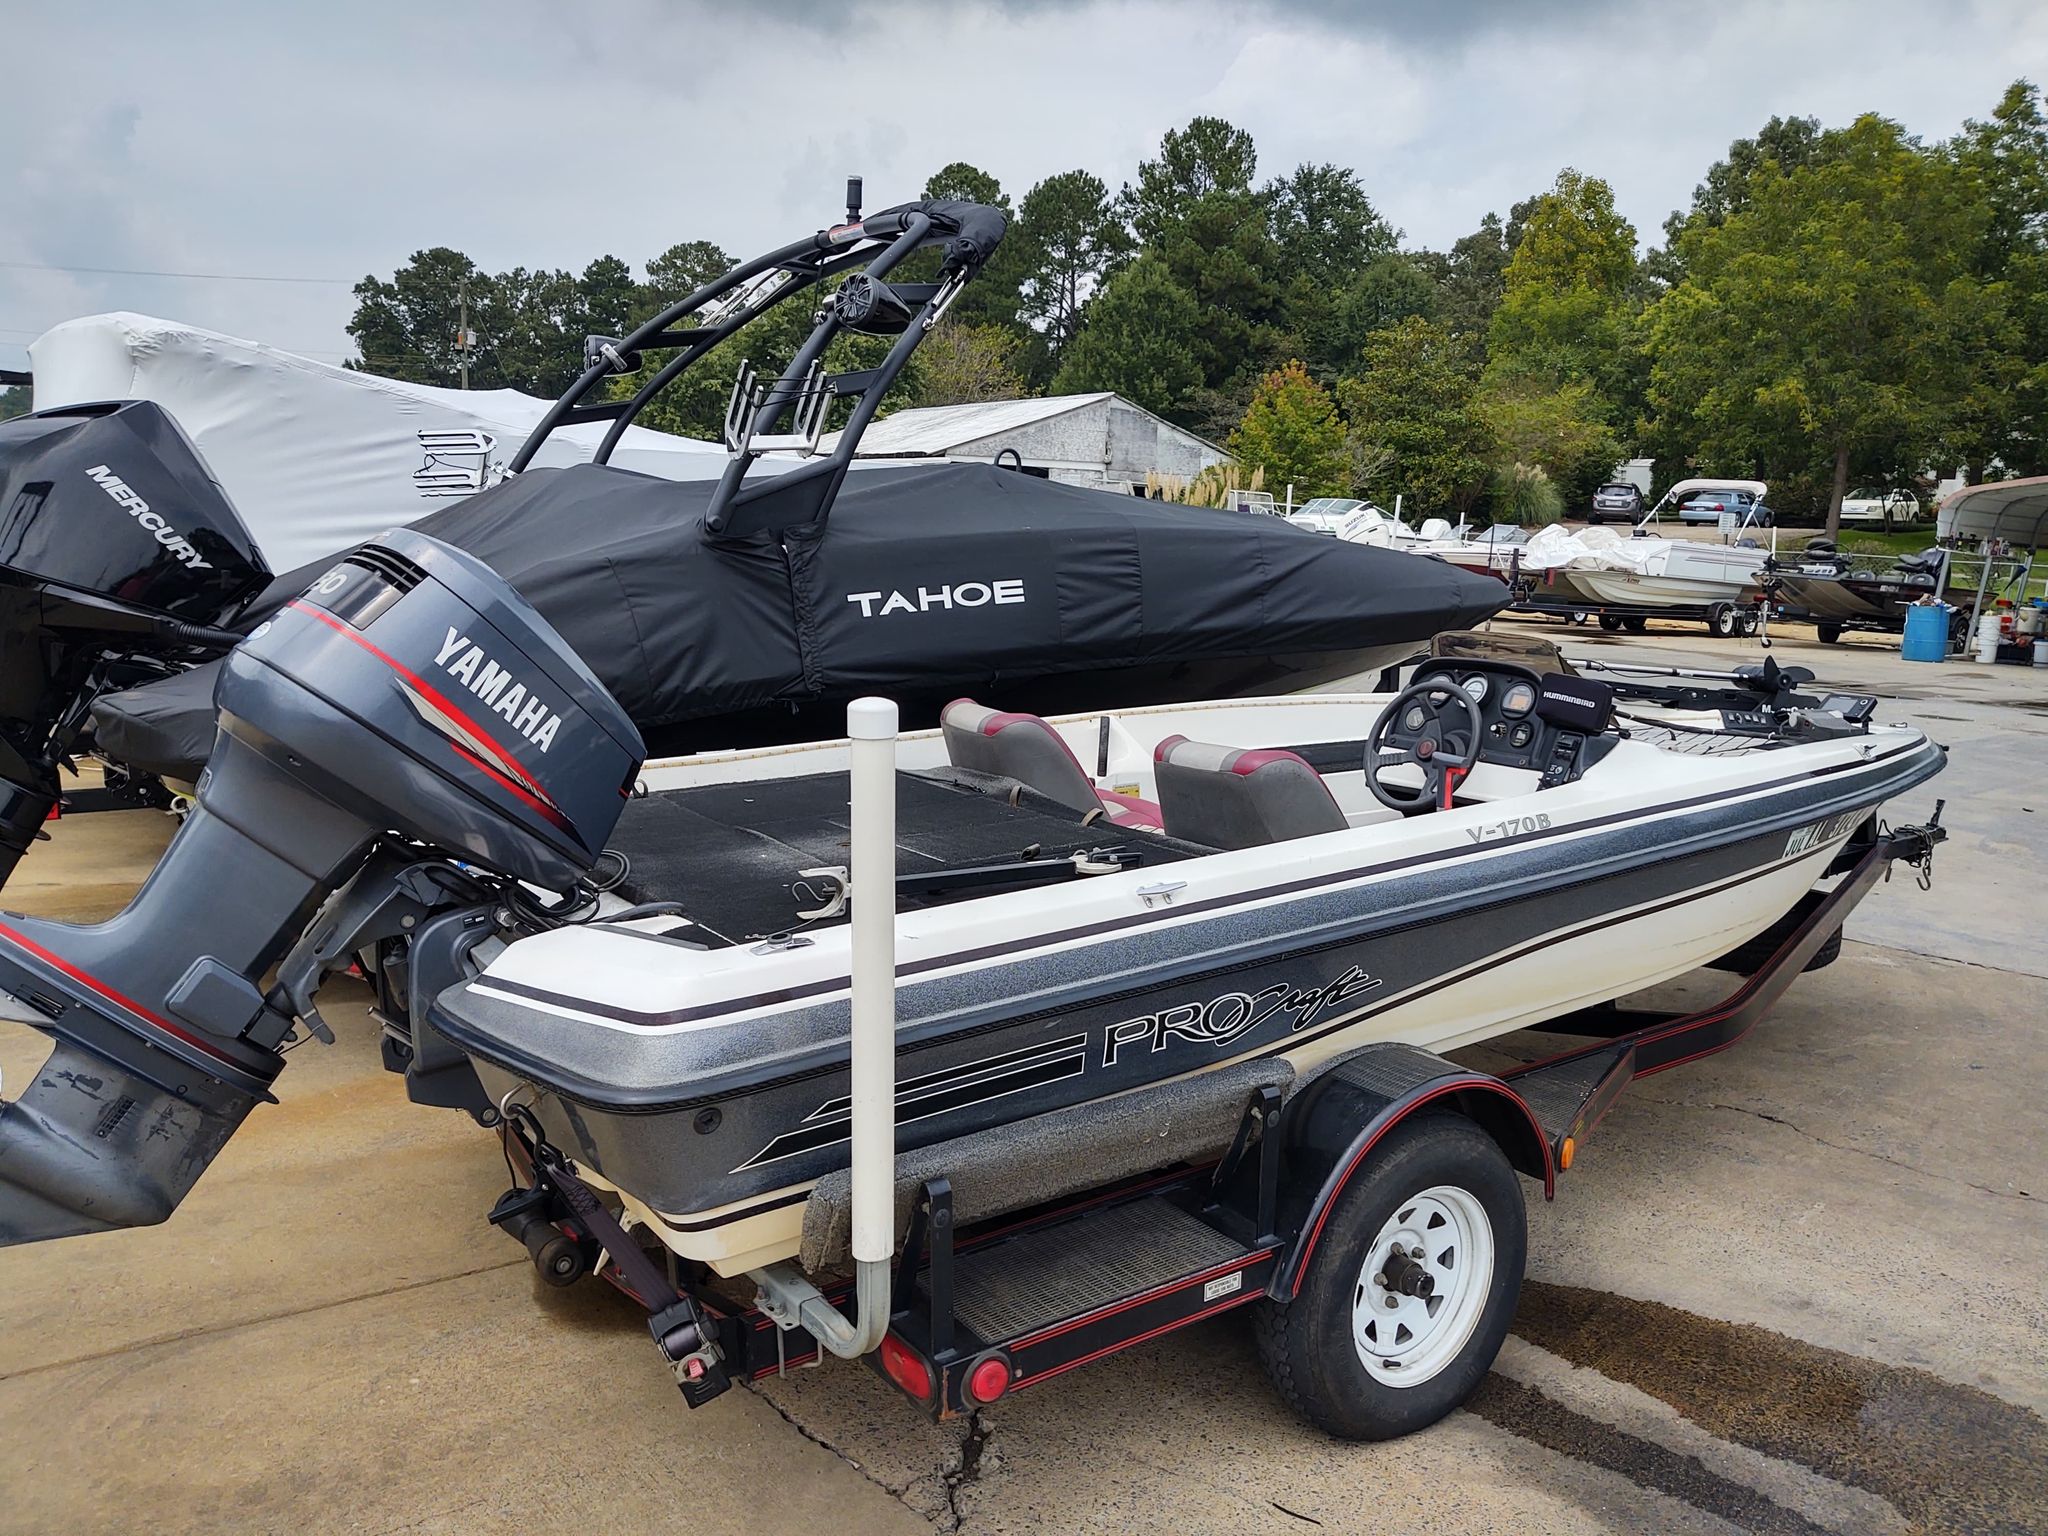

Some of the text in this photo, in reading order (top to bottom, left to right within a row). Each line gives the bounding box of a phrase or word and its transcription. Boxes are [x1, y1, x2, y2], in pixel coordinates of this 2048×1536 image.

[85, 464, 213, 569] MERCURY
[847, 580, 1025, 617] TAHOE
[434, 625, 561, 753] YAMAHA
[1543, 691, 1595, 708] HUMMINBIRD
[1465, 812, 1551, 843] V-170B
[1102, 965, 1382, 1068] PRO Craft
